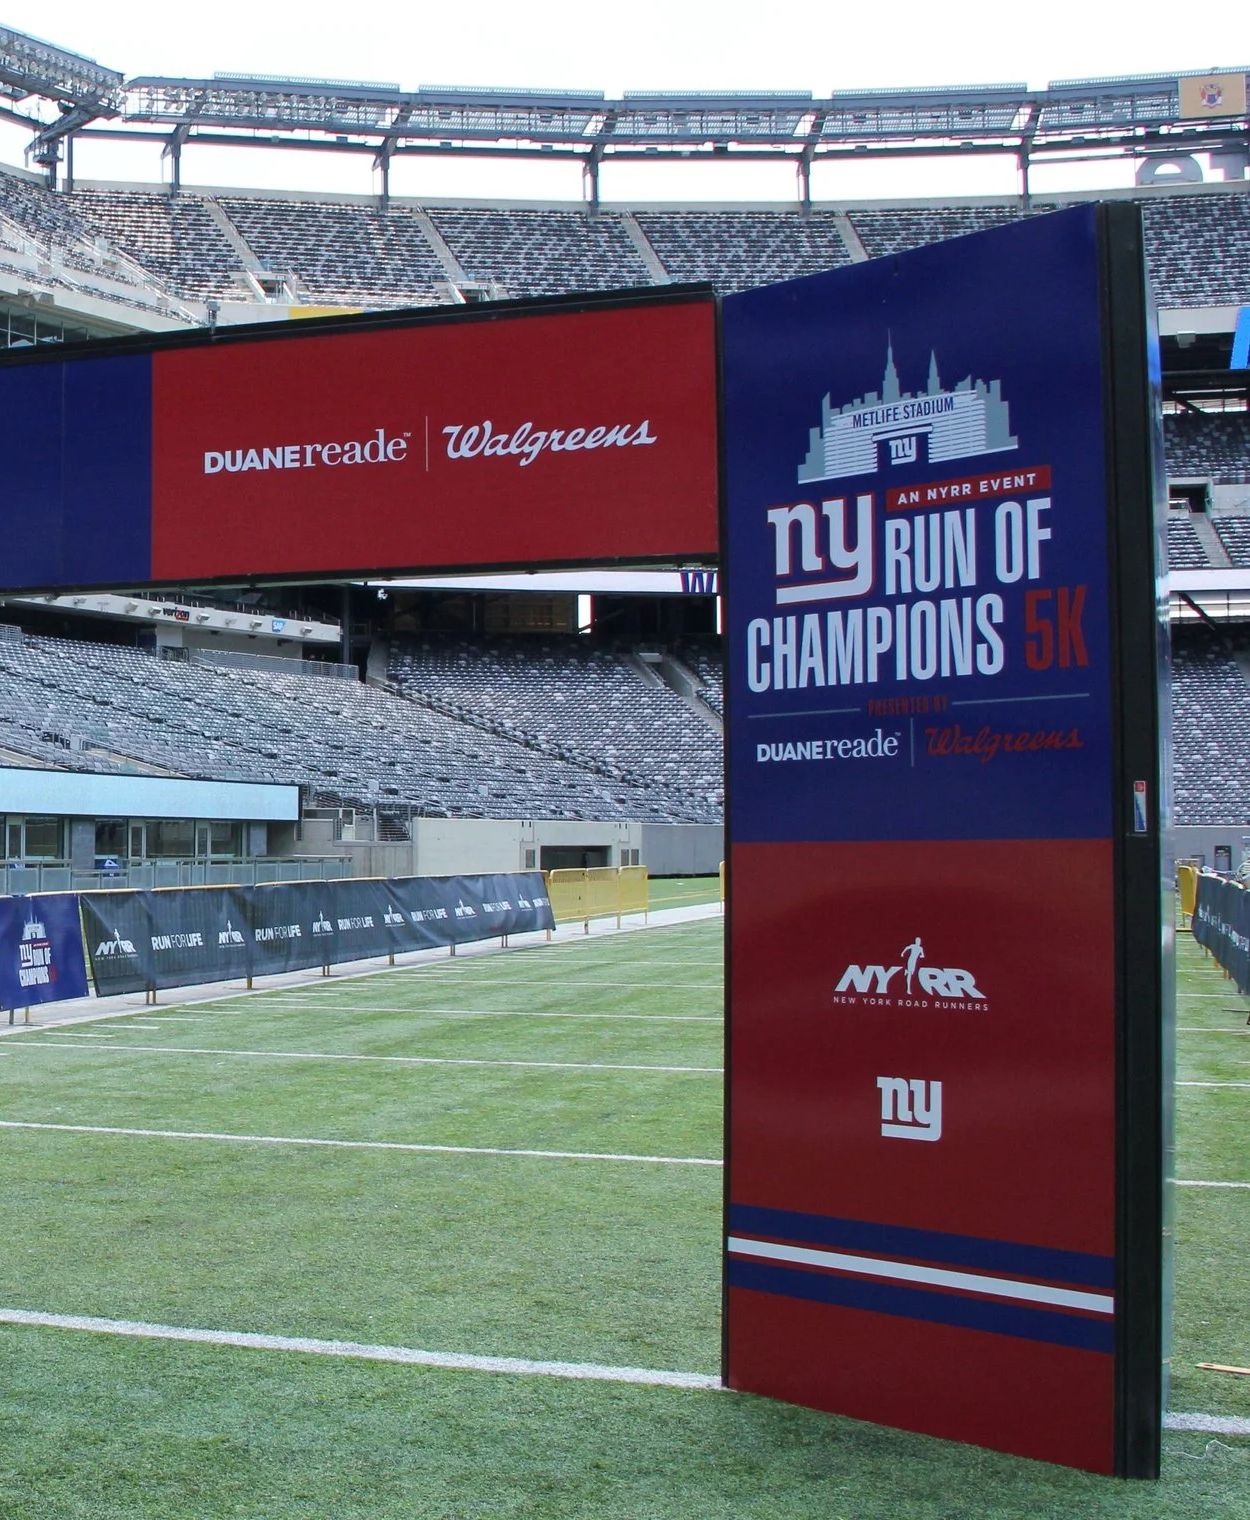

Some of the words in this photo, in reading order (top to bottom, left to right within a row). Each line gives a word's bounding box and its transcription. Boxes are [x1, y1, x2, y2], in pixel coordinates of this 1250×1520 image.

[852, 405, 899, 429] METLIFE
[903, 396, 954, 420] STADIUM
[442, 420, 657, 467] Walgreens
[897, 491, 919, 505] AN
[927, 484, 972, 502] NYRR
[979, 473, 1037, 494] EVENT
[767, 494, 873, 605] ny
[885, 508, 977, 596] RUN
[995, 497, 1052, 584] OF
[747, 593, 1004, 693] CHAMPIONS
[1024, 585, 1089, 671] 5K
[925, 725, 1084, 763] Walgreens
[833, 996, 856, 1005] NEW
[863, 997, 892, 1007] YORK
[898, 999, 928, 1008] ROAD
[935, 1001, 989, 1011] RUNNERS
[876, 1076, 942, 1142] ny
